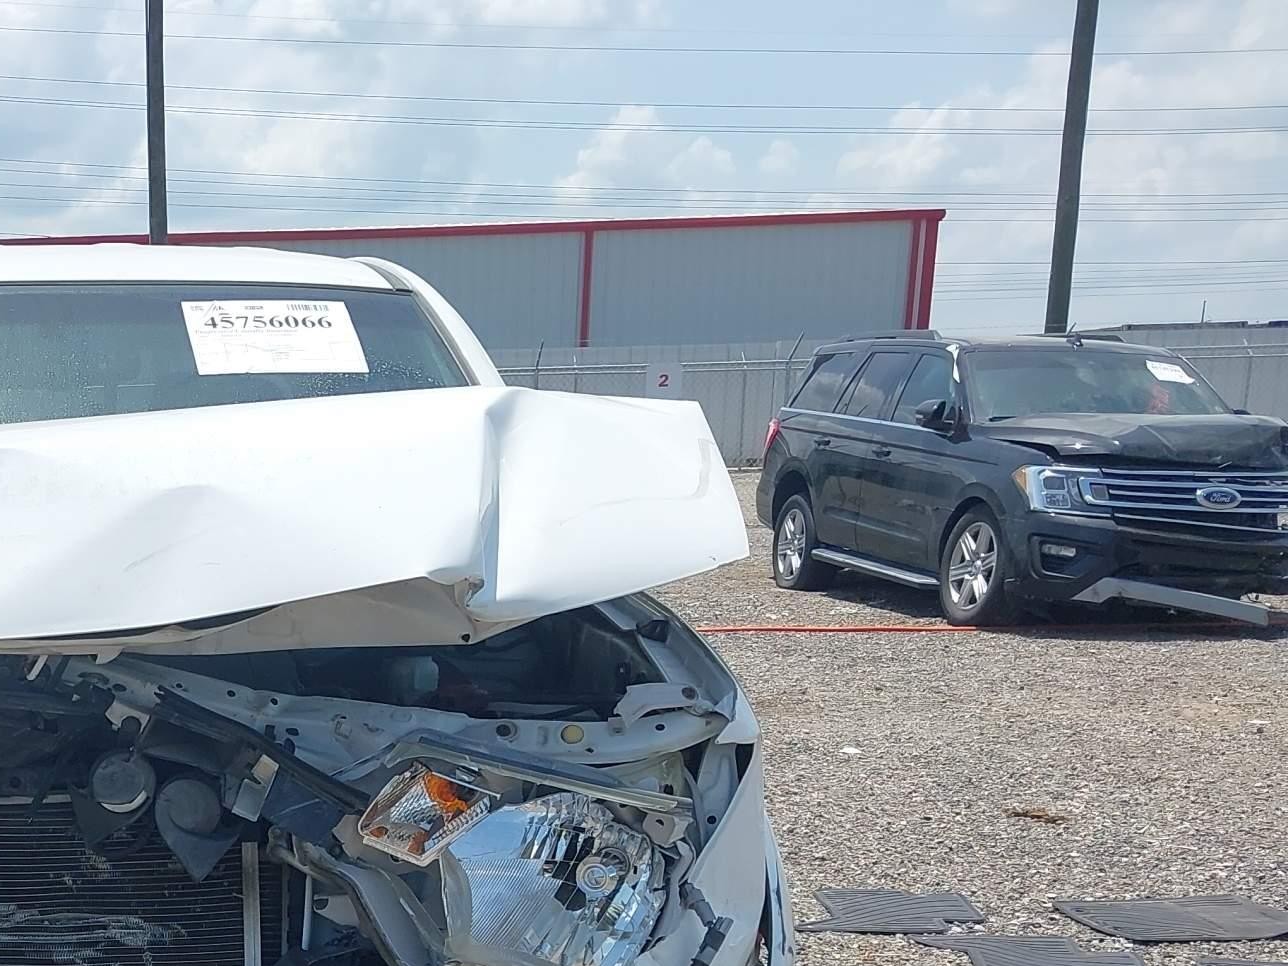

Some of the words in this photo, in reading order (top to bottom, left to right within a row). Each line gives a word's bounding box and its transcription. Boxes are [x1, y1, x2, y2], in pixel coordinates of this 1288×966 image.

[204, 315, 333, 328] 45756066
[658, 374, 669, 388] 2
[1210, 492, 1232, 503] Ford
